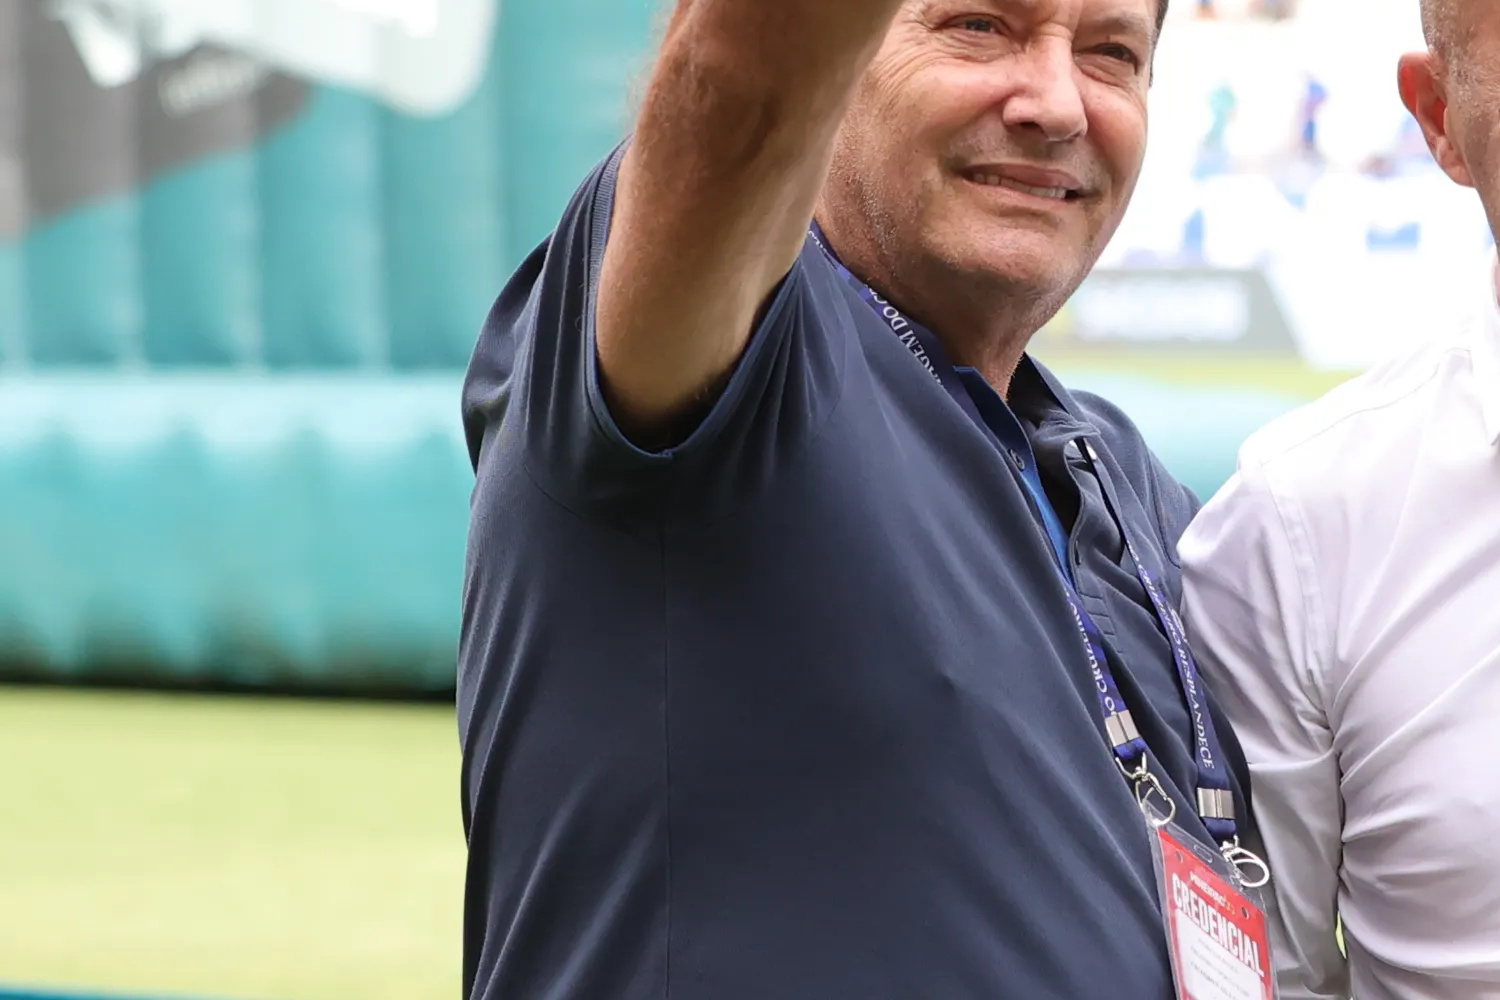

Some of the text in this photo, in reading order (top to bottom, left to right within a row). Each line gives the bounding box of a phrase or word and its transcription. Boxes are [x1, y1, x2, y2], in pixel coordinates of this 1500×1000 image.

[883, 306, 908, 331] DO
[1178, 648, 1214, 769] RESPLANDECE
[1172, 873, 1264, 977] CREDENCIAL
